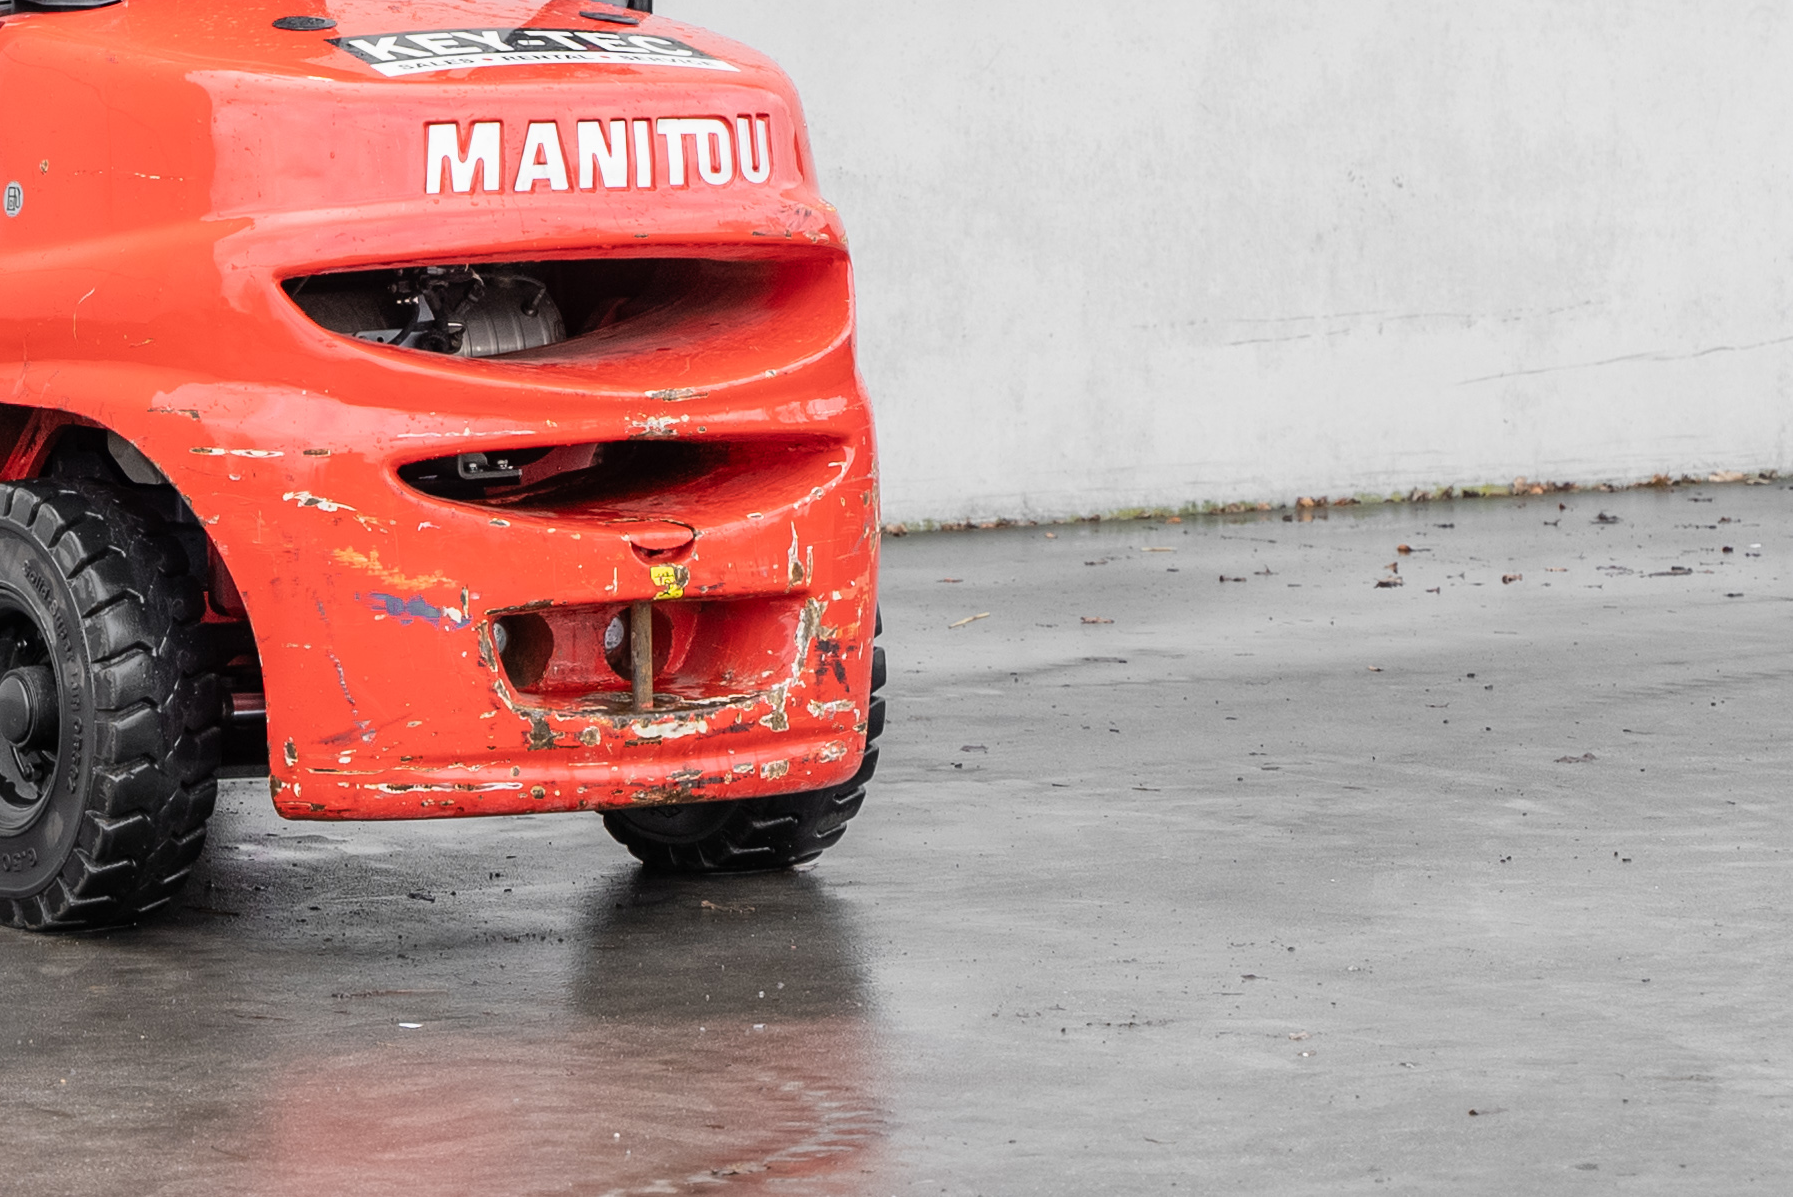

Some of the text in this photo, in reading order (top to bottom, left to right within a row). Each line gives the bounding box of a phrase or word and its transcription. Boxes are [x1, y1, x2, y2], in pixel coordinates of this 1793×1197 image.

[348, 30, 693, 62] KEY-TEC
[398, 58, 474, 70] SALES
[618, 55, 716, 66] SERVICE
[425, 118, 770, 194] MANITOU
